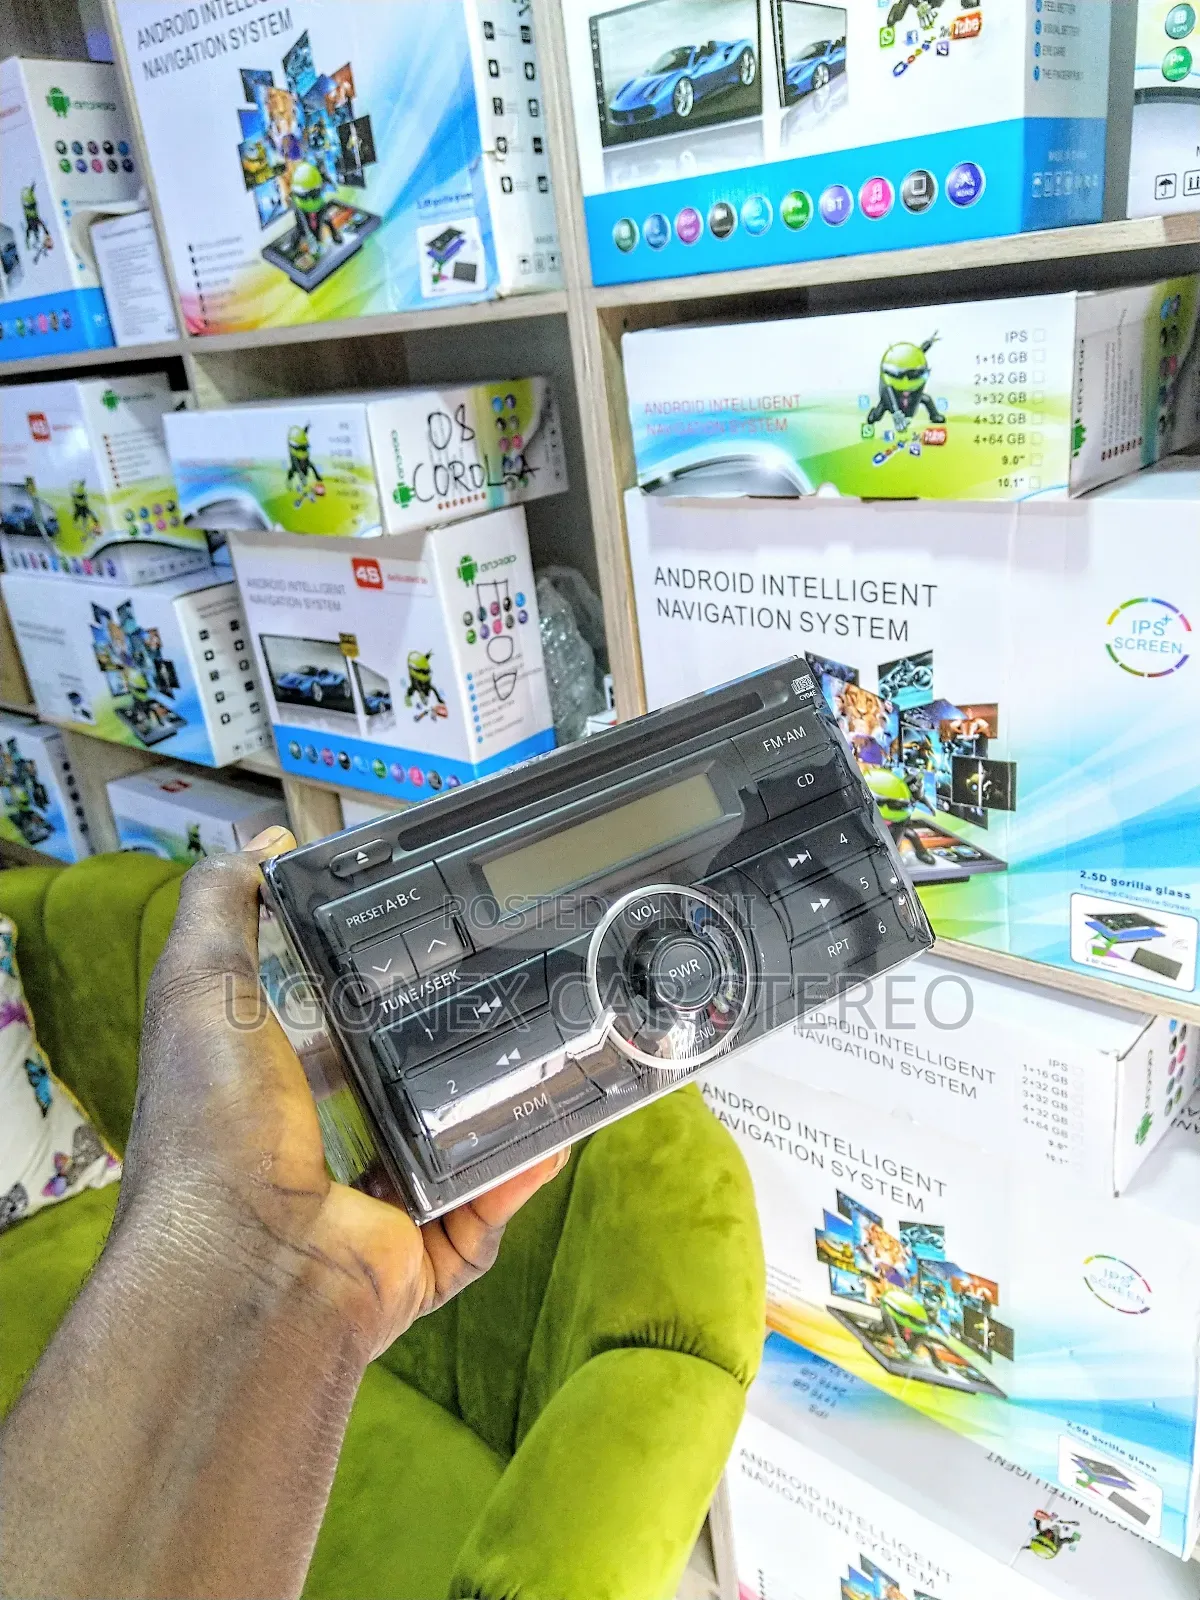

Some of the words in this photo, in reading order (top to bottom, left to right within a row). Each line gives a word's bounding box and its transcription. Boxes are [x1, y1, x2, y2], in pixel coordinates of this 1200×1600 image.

[136, 8, 200, 51] ANDROID
[141, 33, 228, 80] NAVIGATION
[227, 8, 294, 51] SYSTEM
[1005, 330, 1028, 343] IPS
[1008, 350, 1028, 364] GB
[1008, 371, 1027, 384] GB
[645, 400, 704, 416] ANDROID
[709, 394, 800, 413] INTELLIGENT
[1008, 392, 1027, 405] GB
[729, 417, 788, 434] SYSTEM
[1007, 413, 1026, 425] GB
[1007, 433, 1026, 446] GB
[655, 566, 755, 594] ANDROID
[761, 573, 938, 608] INTELLIGENT
[656, 597, 792, 631] NAVIGATION
[799, 610, 909, 642] SYSTEM
[1113, 636, 1182, 655] SCREEN
[796, 773, 815, 788] CD
[839, 832, 848, 845] 4
[859, 876, 870, 890] 5
[1080, 870, 1107, 883] 2.5D
[1111, 877, 1152, 892] gorilla
[1155, 885, 1191, 900] glass
[345, 905, 385, 928] PRESET
[631, 903, 661, 921] VOL
[878, 921, 887, 934] 6
[827, 938, 850, 958] RPT
[668, 958, 701, 983] PWR
[379, 968, 462, 1014] TUNE/SEEK
[425, 1028, 433, 1041] 1
[694, 1024, 716, 1044] ENU
[793, 1025, 895, 1070] NAVIGATION
[900, 1060, 978, 1100] SYSTEM
[874, 1031, 997, 1084] INTELLIGENT
[1048, 1058, 1068, 1072] IPS
[447, 1080, 458, 1094] 2
[1051, 1073, 1068, 1085] GB
[1051, 1086, 1068, 1098] GB
[512, 1092, 548, 1120] RDM
[1051, 1099, 1068, 1112] GB
[1051, 1113, 1068, 1126] GB
[468, 1131, 479, 1147] 3
[702, 1082, 791, 1131] ANDROID
[797, 1121, 948, 1197] INTELLIGENT
[1051, 1126, 1068, 1139] GB
[831, 1160, 925, 1213] SYSTEM
[739, 1447, 821, 1502] ANDROID
[825, 1496, 953, 1584] INTELLIGENT
[740, 1463, 850, 1536] NAVIGATION
[854, 1530, 937, 1590] SYSTEM
